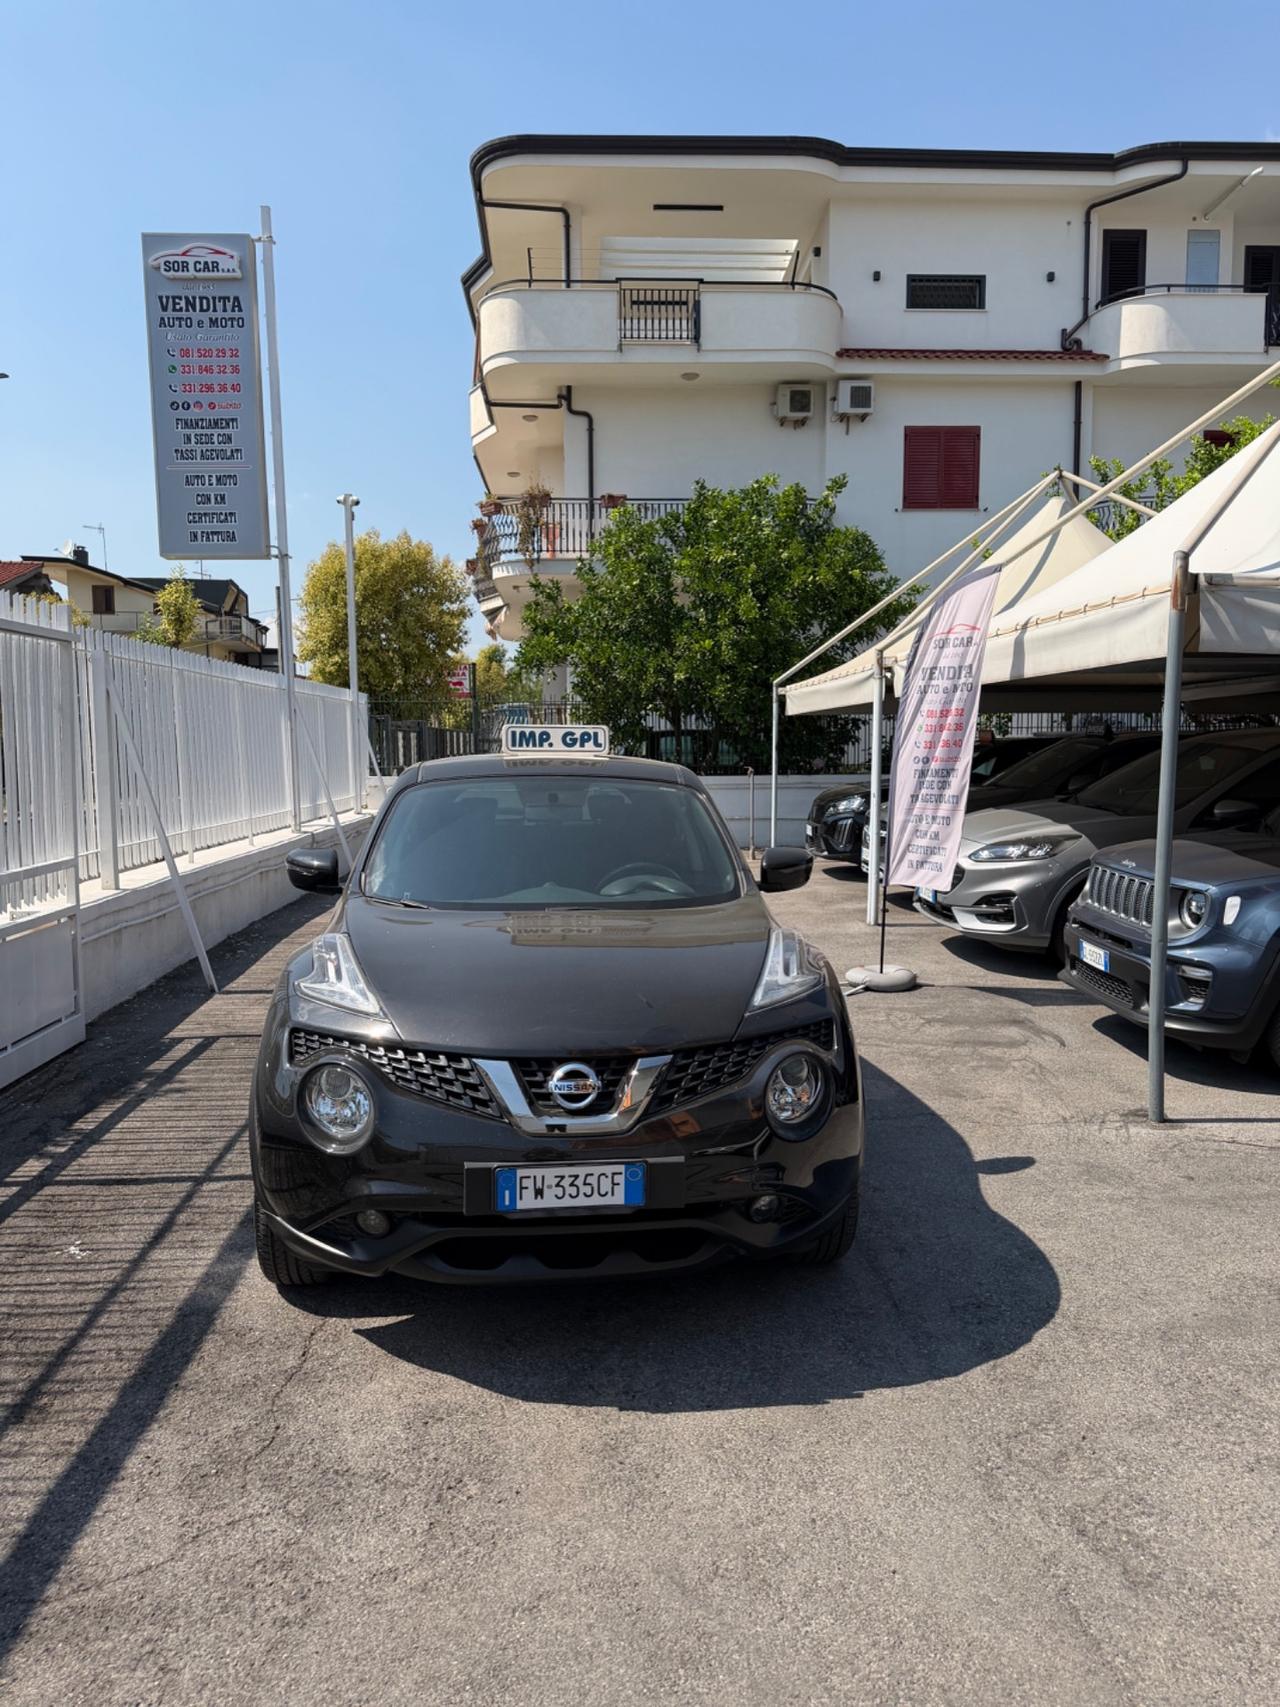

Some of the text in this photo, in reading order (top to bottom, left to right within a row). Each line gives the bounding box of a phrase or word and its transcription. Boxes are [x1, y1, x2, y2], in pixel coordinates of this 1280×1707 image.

[163, 260, 189, 272] SOR
[194, 260, 220, 272] CAR
[158, 295, 243, 312] VENDITA
[159, 317, 245, 329] AUTO e MOTO
[175, 418, 239, 430] FINANZIAMENTI
[183, 433, 232, 445] IN SEDE CON
[174, 449, 243, 461] TASSI AGEVOLATI
[185, 475, 238, 487] AUTO E MOTO
[196, 494, 226, 505] CON KM
[187, 512, 237, 524] CERTIFICATI
[190, 531, 237, 542] IN FATTURA
[952, 636, 974, 647] CAR
[511, 730, 602, 748] IMP. GPL
[554, 1082, 597, 1092] NISSAN
